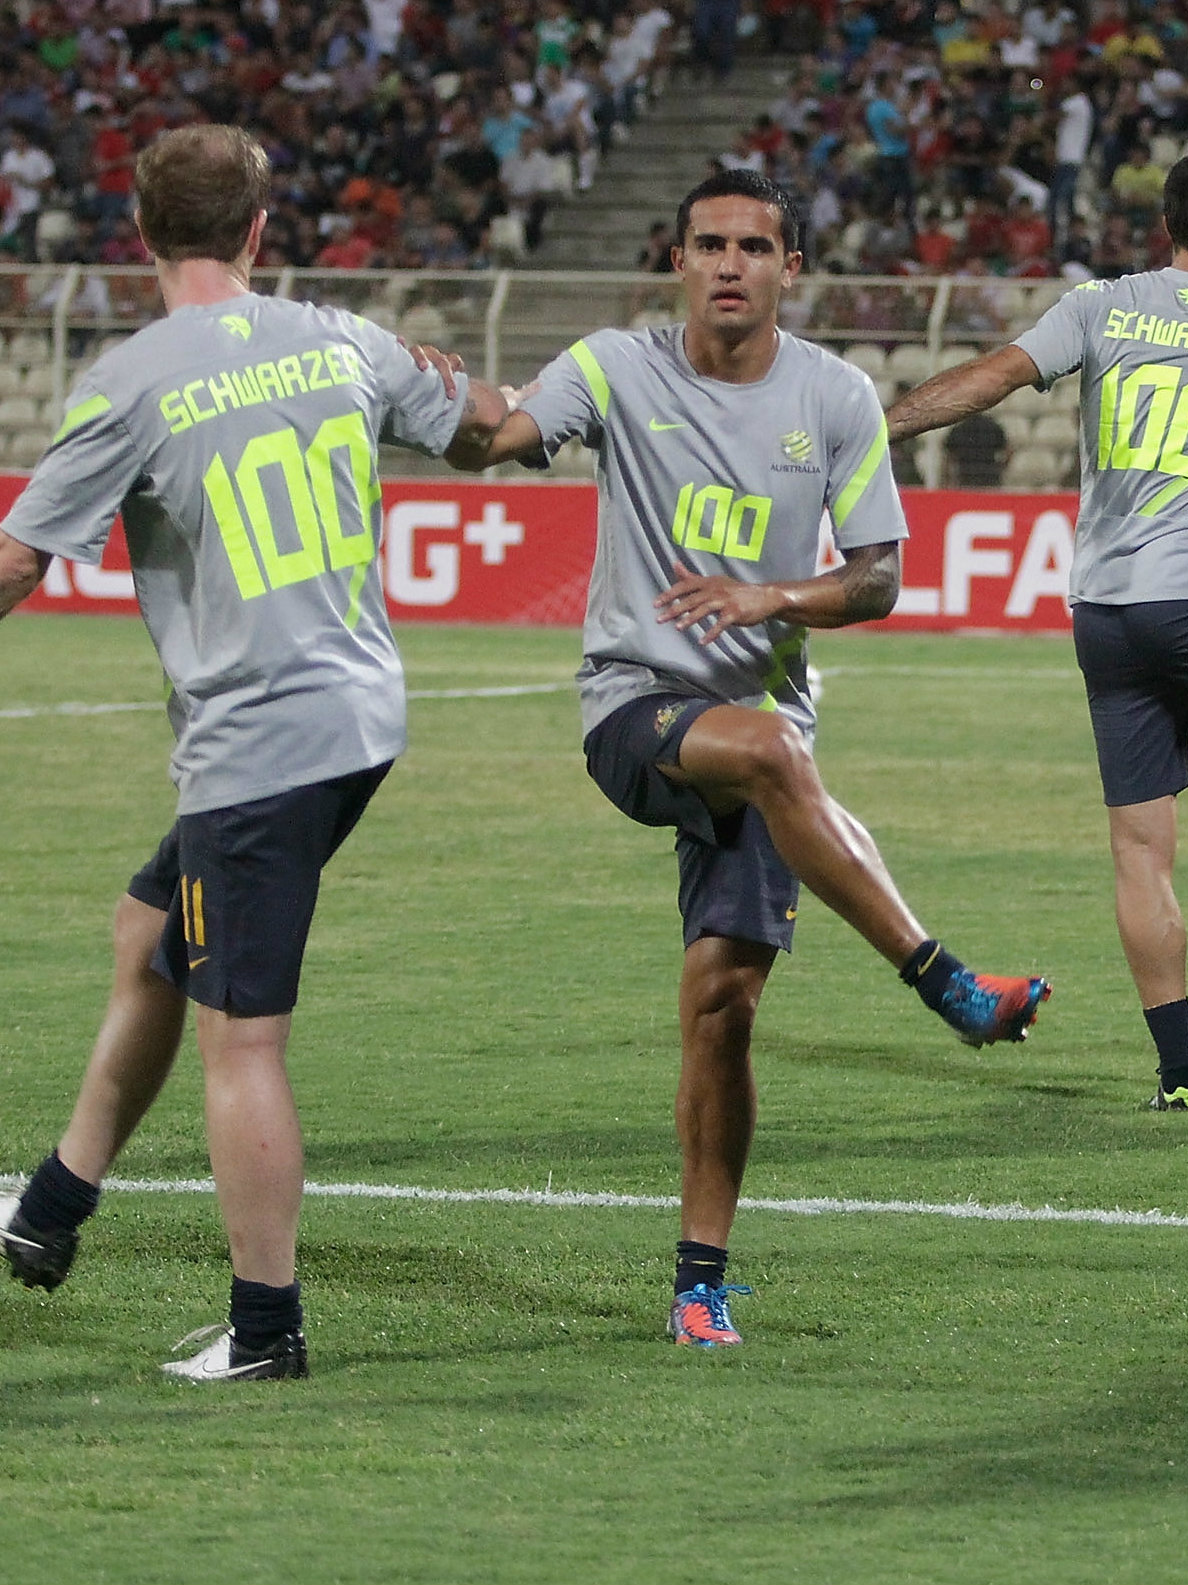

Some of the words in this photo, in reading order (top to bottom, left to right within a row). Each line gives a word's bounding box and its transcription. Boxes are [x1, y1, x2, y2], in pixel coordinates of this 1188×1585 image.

[159, 344, 362, 435] SCHWARZER
[203, 411, 375, 601] 100
[770, 463, 821, 474] AUSTRALIA
[381, 500, 525, 606] G+
[671, 482, 772, 562] 100
